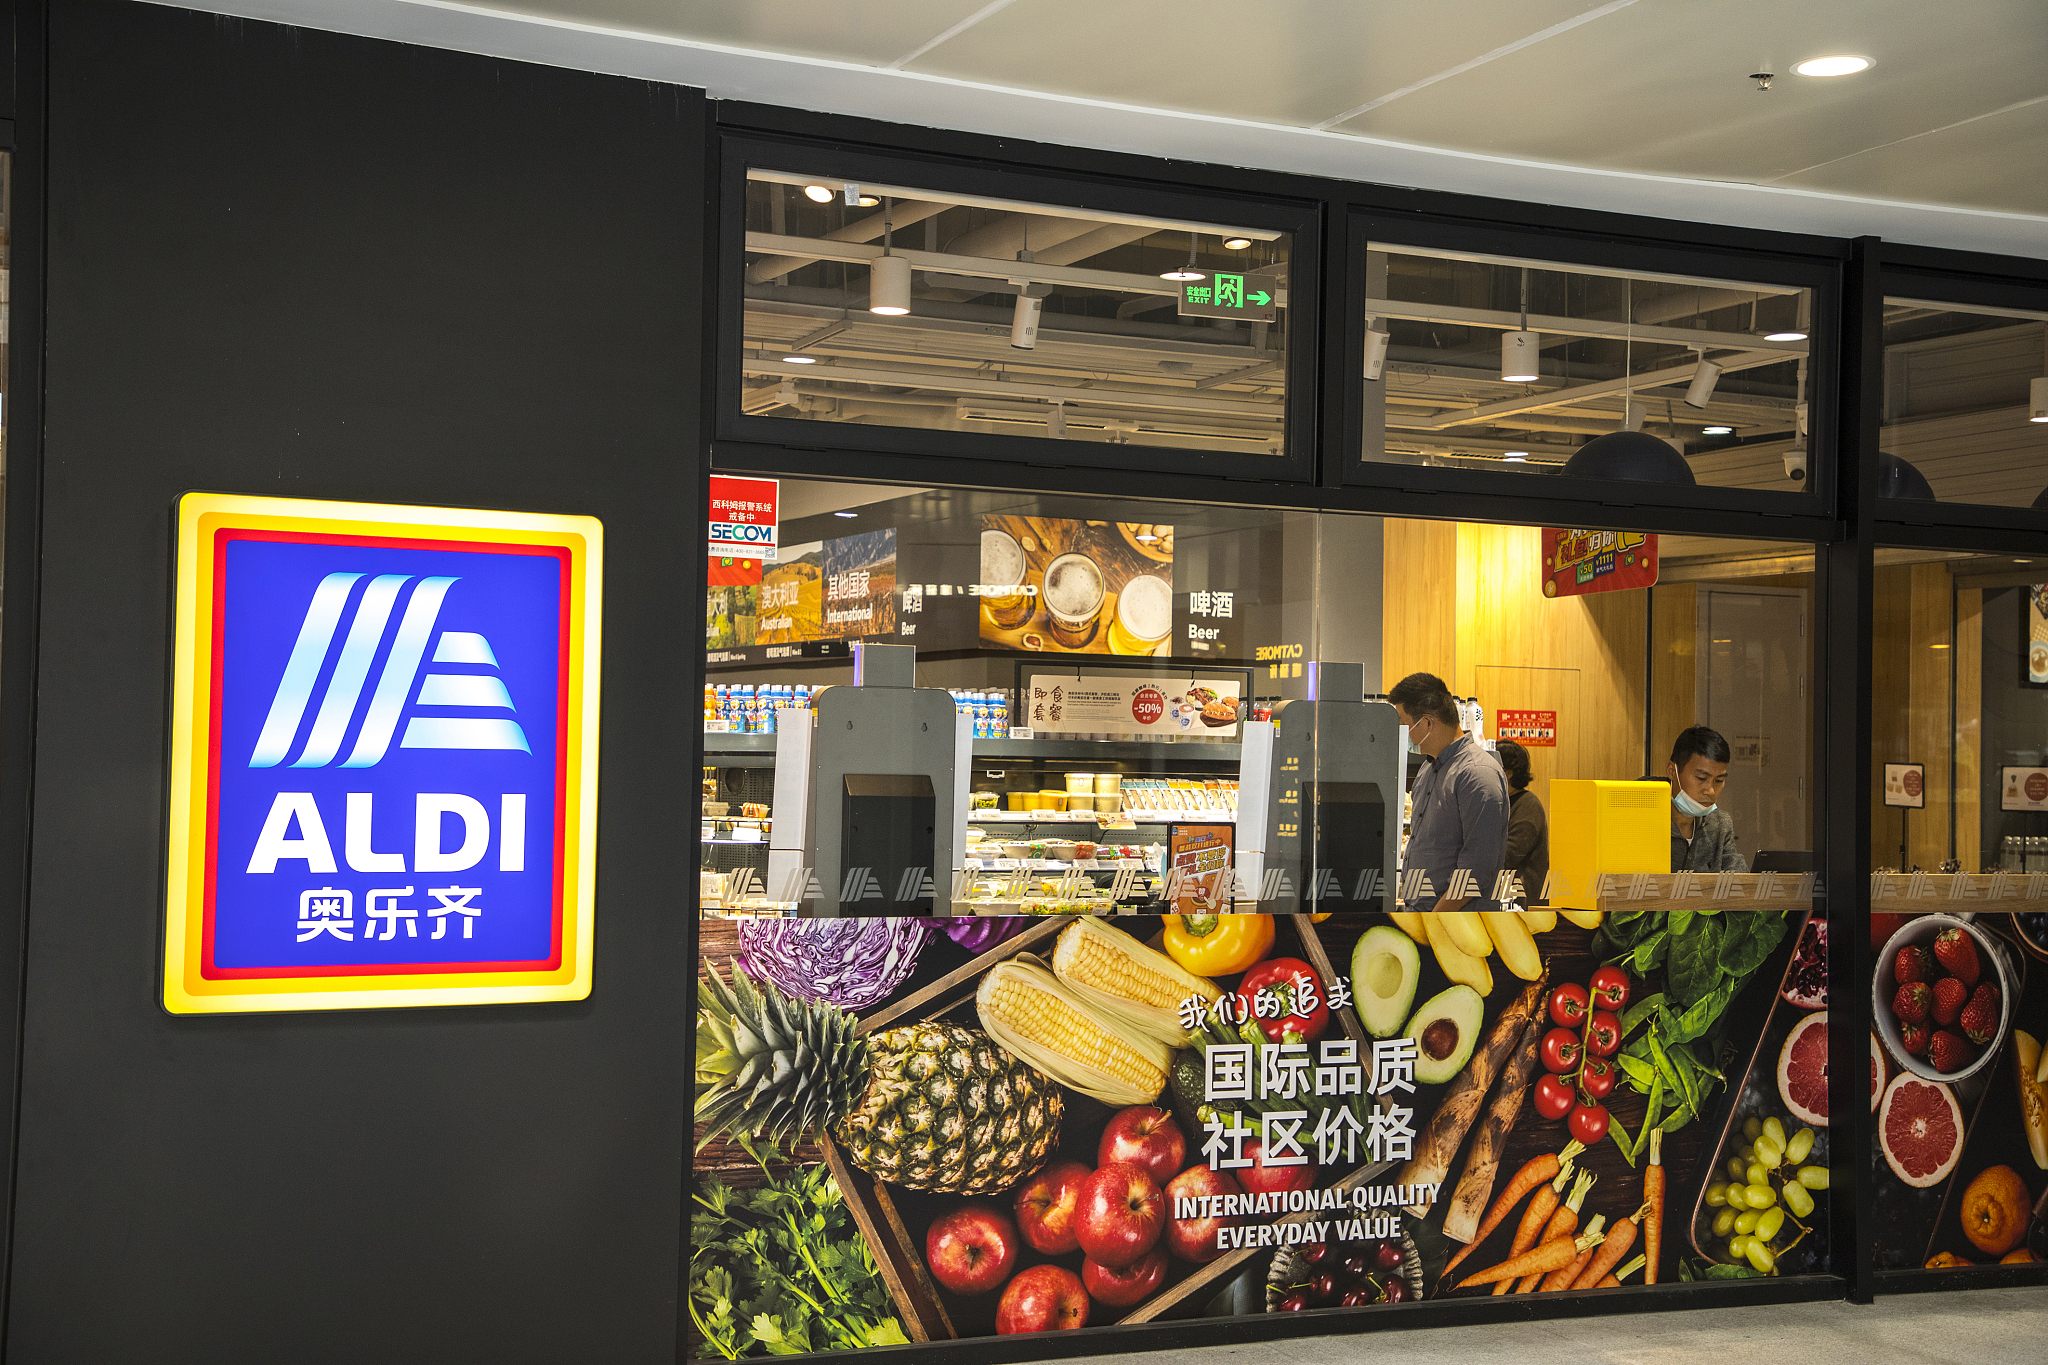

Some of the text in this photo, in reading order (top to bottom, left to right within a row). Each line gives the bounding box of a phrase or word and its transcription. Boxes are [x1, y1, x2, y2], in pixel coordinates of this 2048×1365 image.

[1186, 286, 1212, 298] 安全出口
[1188, 296, 1210, 304] EXIT
[712, 499, 772, 513] 西科姆报警系统
[728, 511, 755, 522] 戒备中
[711, 523, 772, 542] SECOM
[761, 580, 799, 610] 澳大利亚
[827, 569, 871, 602] 其他国家
[826, 602, 873, 624] International
[1189, 589, 1234, 619] 啤酒
[761, 613, 793, 631] Australian
[901, 621, 917, 636] Beer
[1188, 623, 1220, 640] Beer
[1134, 703, 1162, 714] -50%
[245, 791, 527, 874] ALDI
[296, 885, 483, 943] 奥乐齐
[1177, 975, 1353, 1033] 我们的追求
[1204, 1037, 1418, 1102] 国际品质
[1201, 1103, 1417, 1171] 社区价格
[1174, 1182, 1442, 1220] INTERNATIONAL QUALITY
[1216, 1215, 1402, 1250] EVERYDAY VALUE
